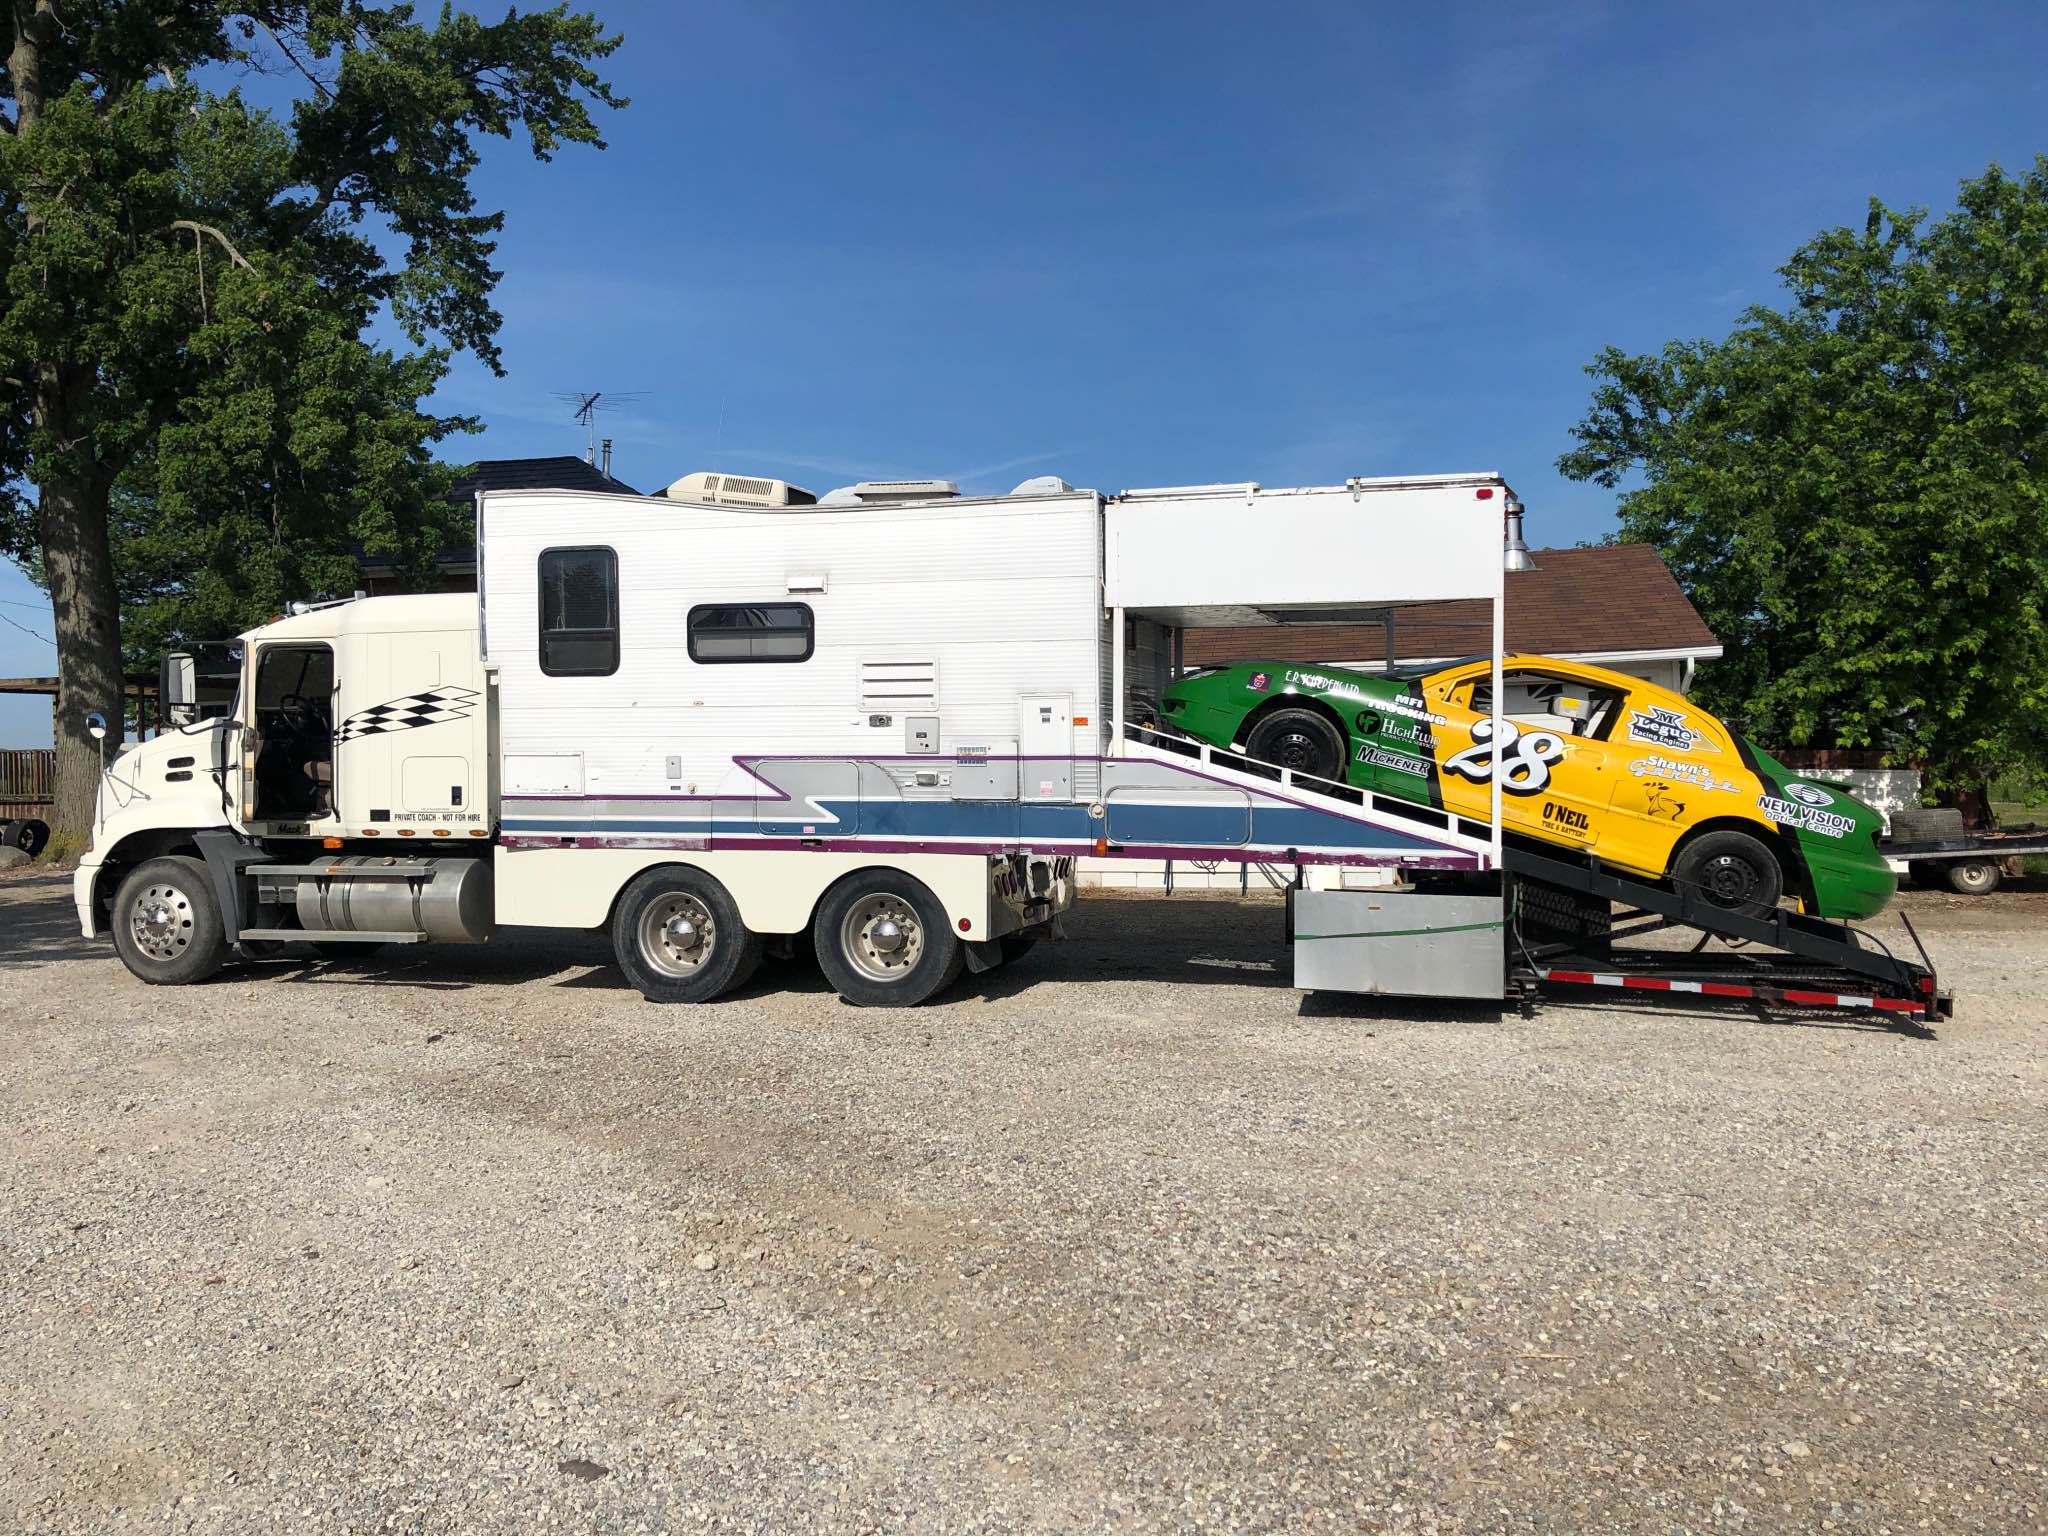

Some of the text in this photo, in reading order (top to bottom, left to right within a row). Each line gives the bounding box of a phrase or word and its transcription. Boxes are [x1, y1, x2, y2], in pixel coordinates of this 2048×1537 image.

[1395, 694, 1424, 708] MFI
[1633, 728, 1689, 749] Racing Engines
[1636, 716, 1693, 742] Legue
[1442, 718, 1566, 797] 28
[1647, 755, 1710, 776] Shawn's
[394, 813, 416, 821] PRIVATE
[417, 813, 437, 822] COACH
[442, 813, 454, 822] NOT
[455, 813, 467, 822] FOR
[468, 813, 481, 822] HIRE
[1543, 802, 1589, 830] O'NEIL
[1757, 795, 1855, 832] NEW VISION
[1764, 810, 1844, 838] Optical Centre
